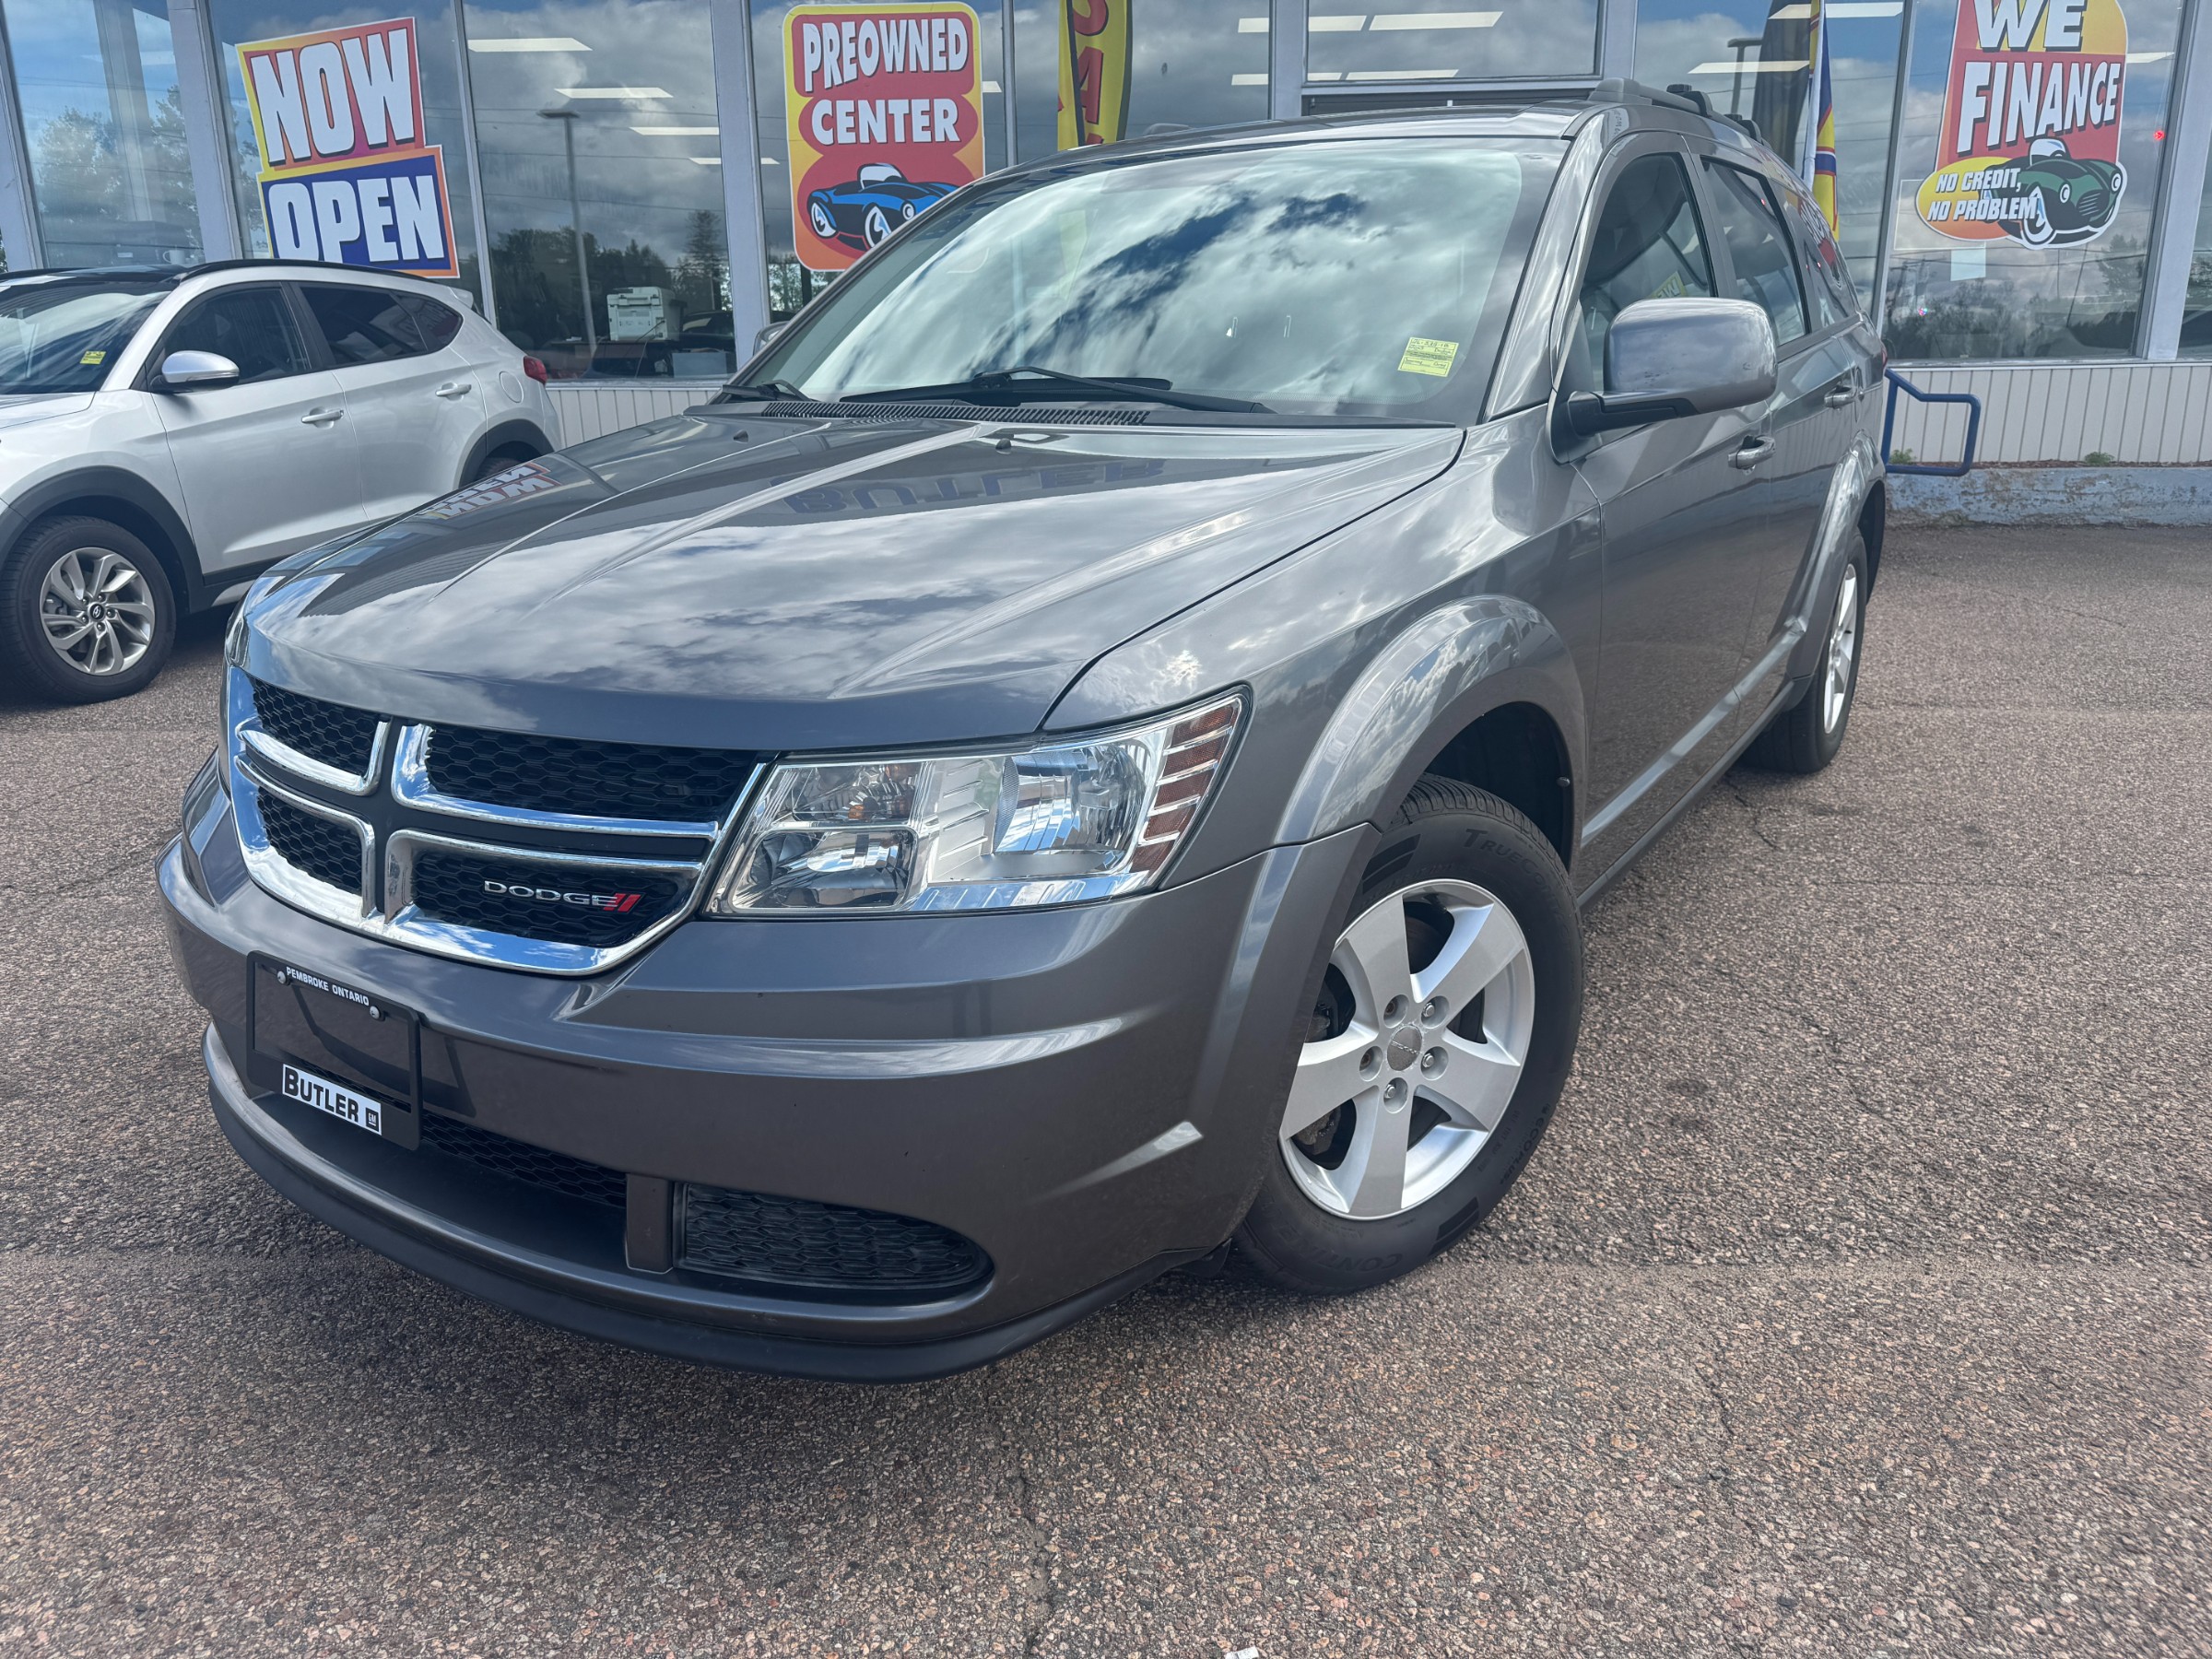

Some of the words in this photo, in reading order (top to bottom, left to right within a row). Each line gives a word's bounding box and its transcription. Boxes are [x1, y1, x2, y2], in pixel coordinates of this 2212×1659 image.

[1974, 0, 2085, 51] WE
[803, 18, 970, 92] PREOWNED
[250, 29, 416, 165] NOW
[811, 97, 960, 145] CENTER
[1957, 62, 2122, 155] FINANCE
[1936, 172, 1957, 193] NO
[1961, 168, 2021, 192] CREDIT,
[268, 175, 445, 264] OPEN
[1927, 199, 1949, 221] NO
[1953, 194, 2038, 221] PROBLEM
[484, 880, 618, 908] DODGE
[286, 966, 329, 992] PEMBROKE
[332, 984, 370, 1006] ONTARIO
[284, 1067, 359, 1123] BUTLER
